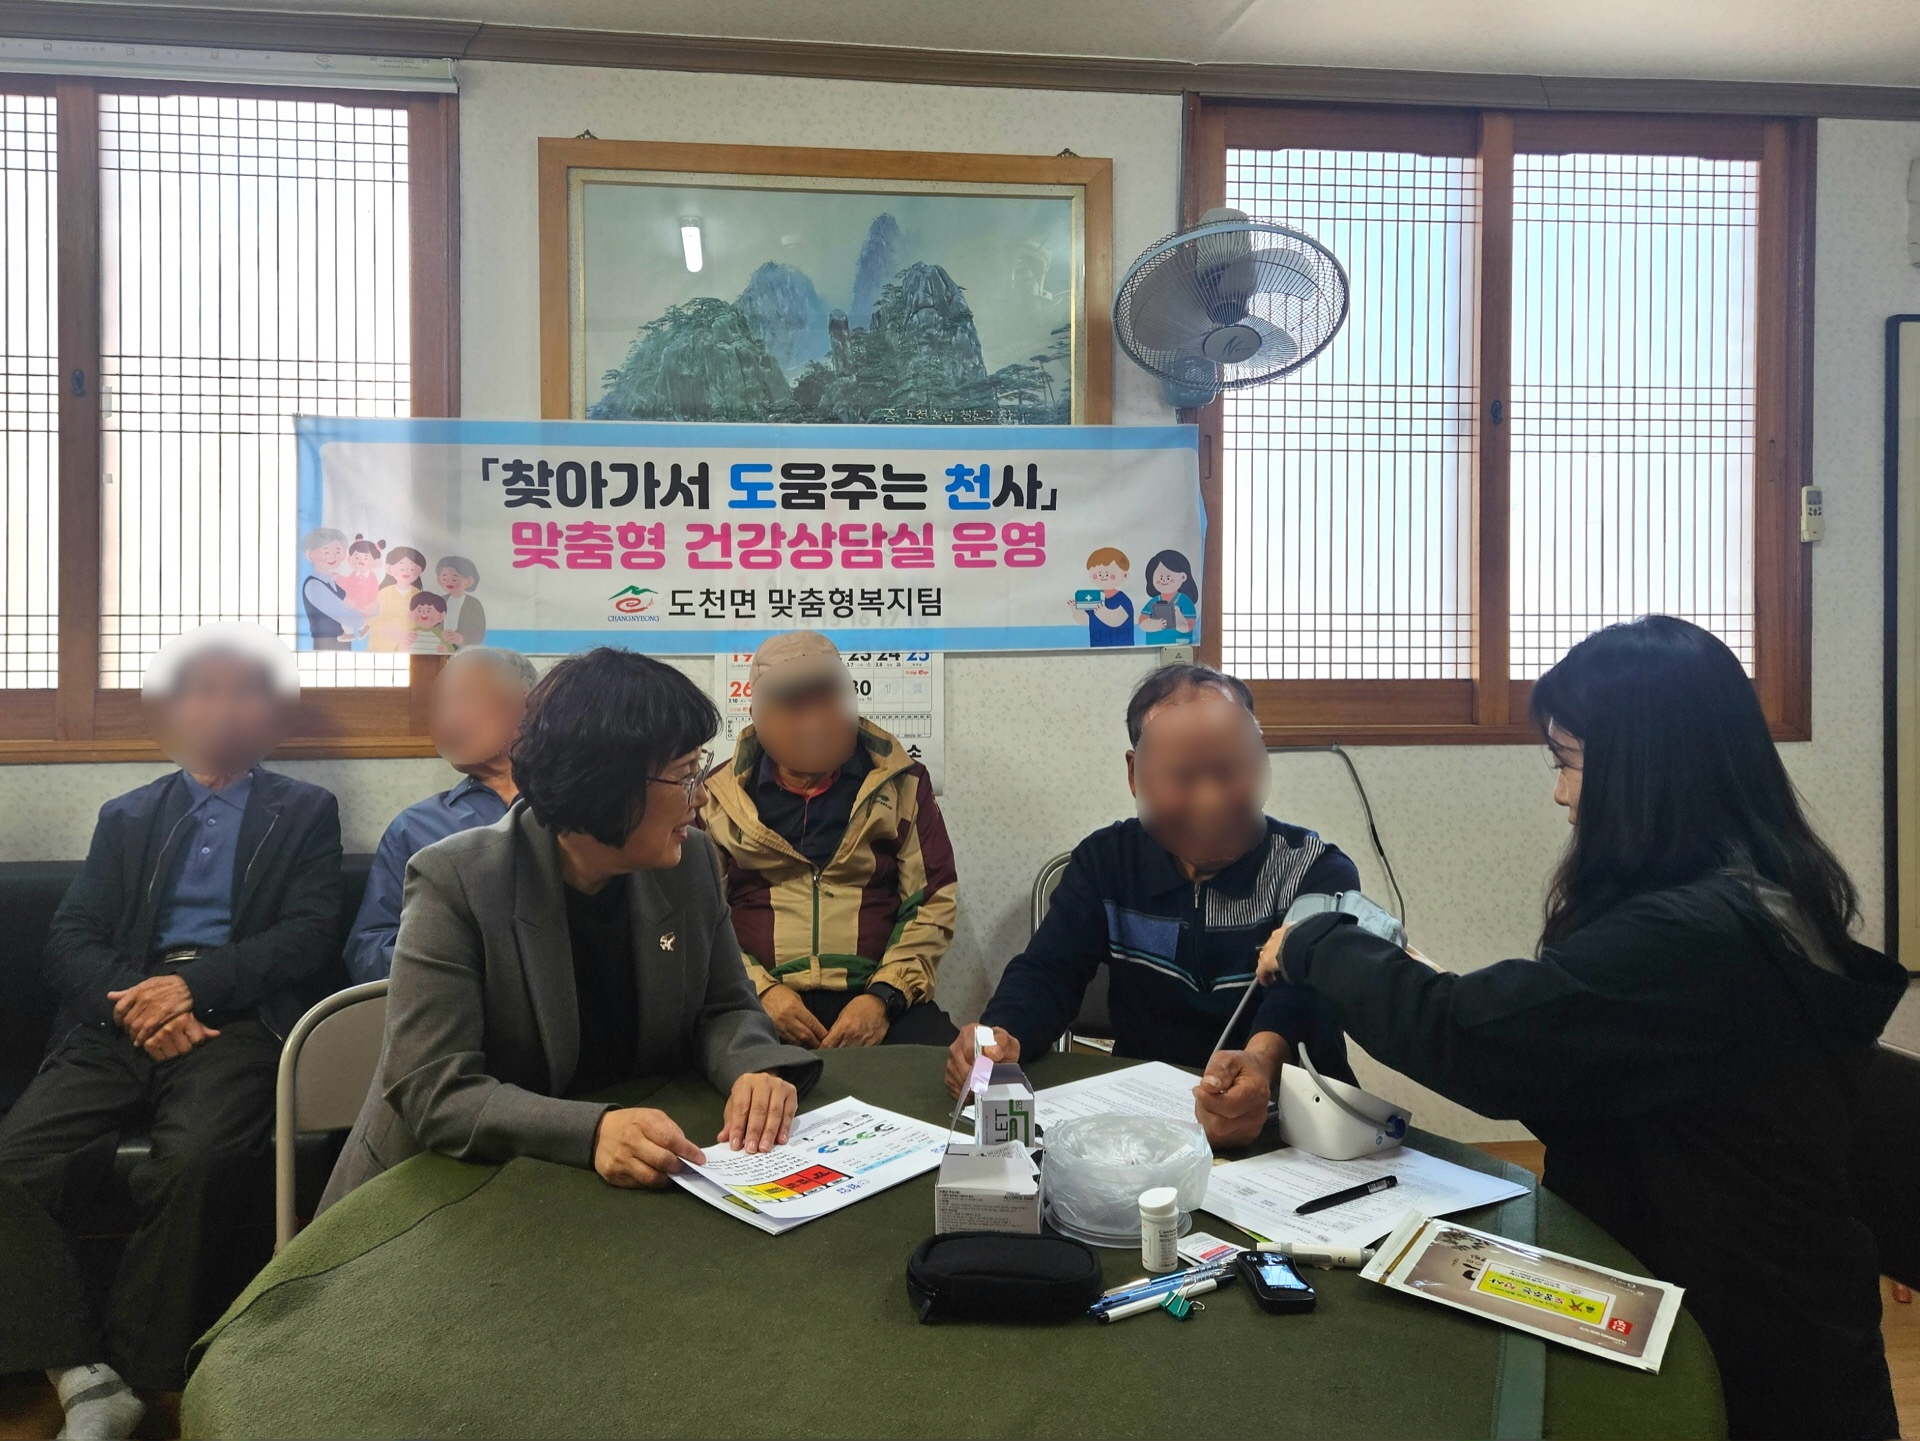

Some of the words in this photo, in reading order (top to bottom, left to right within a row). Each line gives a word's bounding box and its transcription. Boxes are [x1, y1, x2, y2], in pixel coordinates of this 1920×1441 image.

[482, 458, 710, 510] 「찾아가서
[728, 463, 928, 510] 도움주는
[945, 463, 1058, 511] 천사」
[511, 521, 666, 570] 맞춤형
[685, 521, 936, 570] 건강상담실
[951, 521, 1046, 569] 운영
[607, 615, 660, 623] CHANGNYEONG
[668, 588, 756, 619] 도천면
[768, 587, 942, 619] 맞춤형복지팀
